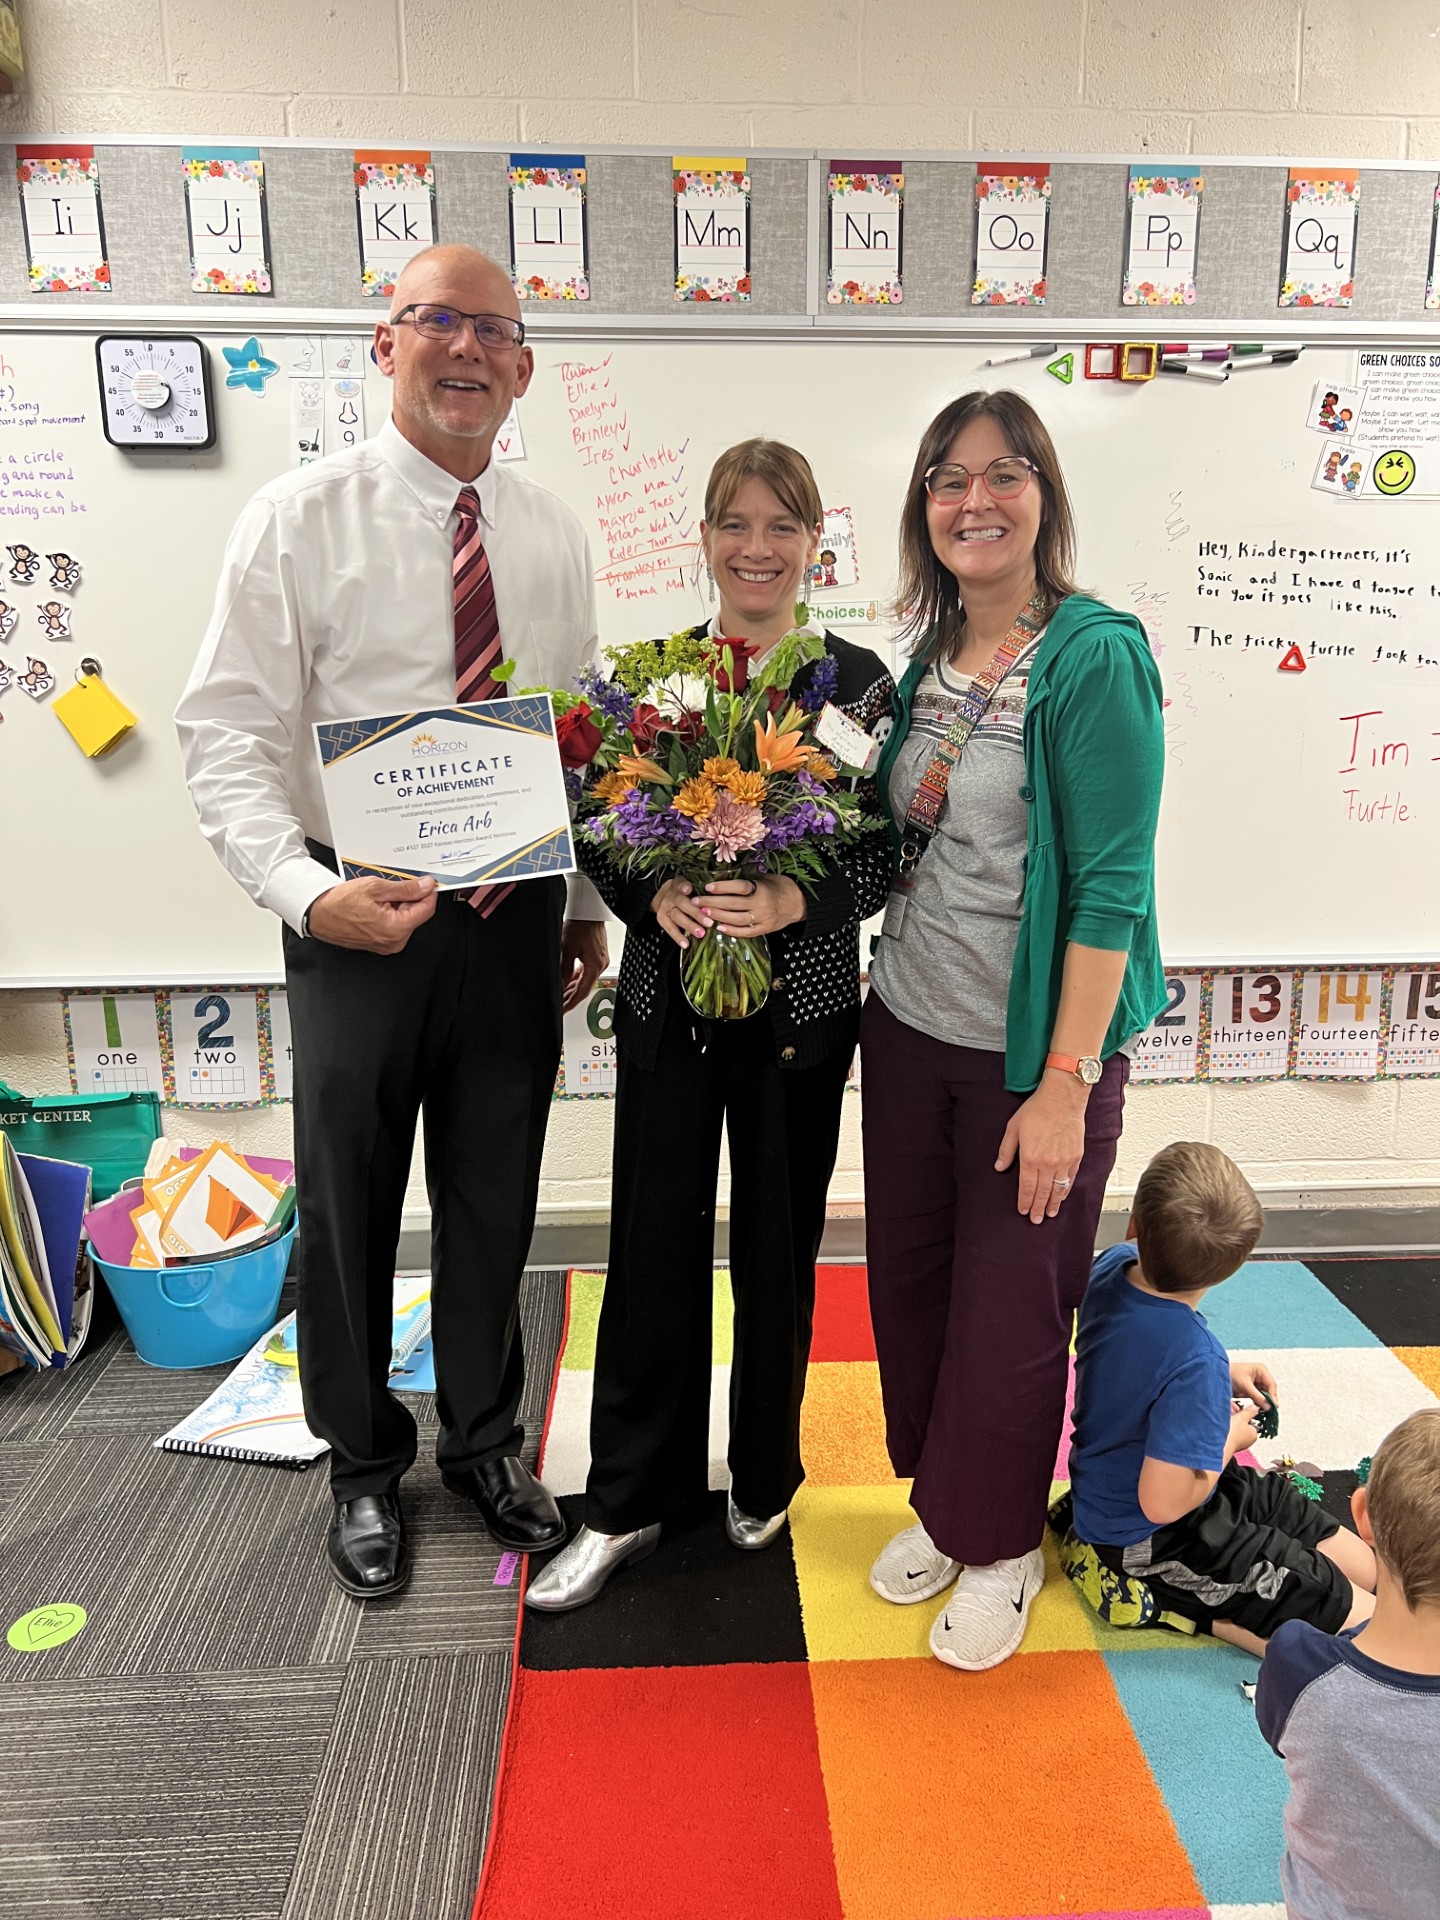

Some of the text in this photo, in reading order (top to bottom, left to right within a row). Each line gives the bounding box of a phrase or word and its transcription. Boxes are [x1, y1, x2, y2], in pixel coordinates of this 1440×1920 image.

[52, 198, 74, 235] Ii
[206, 199, 242, 254] Jj
[375, 204, 418, 241] Kk
[533, 207, 563, 244] Ll
[685, 210, 741, 247] Mm
[845, 213, 889, 249] Nn
[989, 214, 1034, 250] Oo
[1146, 215, 1182, 267] Pp
[1295, 218, 1344, 269] Qq
[110, 365, 120, 373] 50
[1360, 354, 1388, 366] GREEN
[1390, 355, 1426, 367] CHOICES
[108, 387, 117, 395] 45
[567, 382, 598, 403] Ellie
[10, 402, 40, 415] song
[115, 408, 125, 416] 40
[189, 409, 198, 417] 20
[132, 425, 142, 433] 35
[154, 431, 164, 439] 30
[175, 425, 184, 433] 25
[573, 422, 618, 445] Brinley
[8, 455, 17, 464] a
[24, 448, 64, 464] circle
[609, 443, 678, 485] Charlotte
[39, 467, 74, 480] round
[12, 488, 65, 499] make a
[43, 506, 65, 516] can
[71, 501, 87, 513] be
[1199, 541, 1232, 561] Hey,
[1198, 565, 1415, 596] Sonic and I have a tongue
[1197, 584, 1219, 597] for
[1231, 589, 1253, 602] you
[1261, 588, 1275, 602] it
[1281, 594, 1312, 605] goes
[1330, 598, 1362, 612] like
[1187, 625, 1232, 648] The
[1309, 640, 1355, 656] turtle
[411, 740, 468, 756] HORIZON
[1339, 711, 1409, 767] Tim
[374, 755, 513, 785] CERTIFICATE
[397, 776, 495, 797] OF ACHIEVEMENT
[418, 811, 492, 839] Erica Arb
[1231, 975, 1282, 1024] 13
[1318, 974, 1371, 1024] 14
[194, 995, 234, 1049] 2
[587, 988, 616, 1040] 6
[1137, 1028, 1193, 1048] welve
[1213, 1026, 1286, 1043] thirteen
[1299, 1024, 1380, 1040] fourteen
[98, 1051, 137, 1066] one
[194, 1049, 236, 1064] two
[592, 1042, 617, 1057] six
[0, 1110, 92, 1125] KET CENTER
[34, 1617, 63, 1628] Ellie
